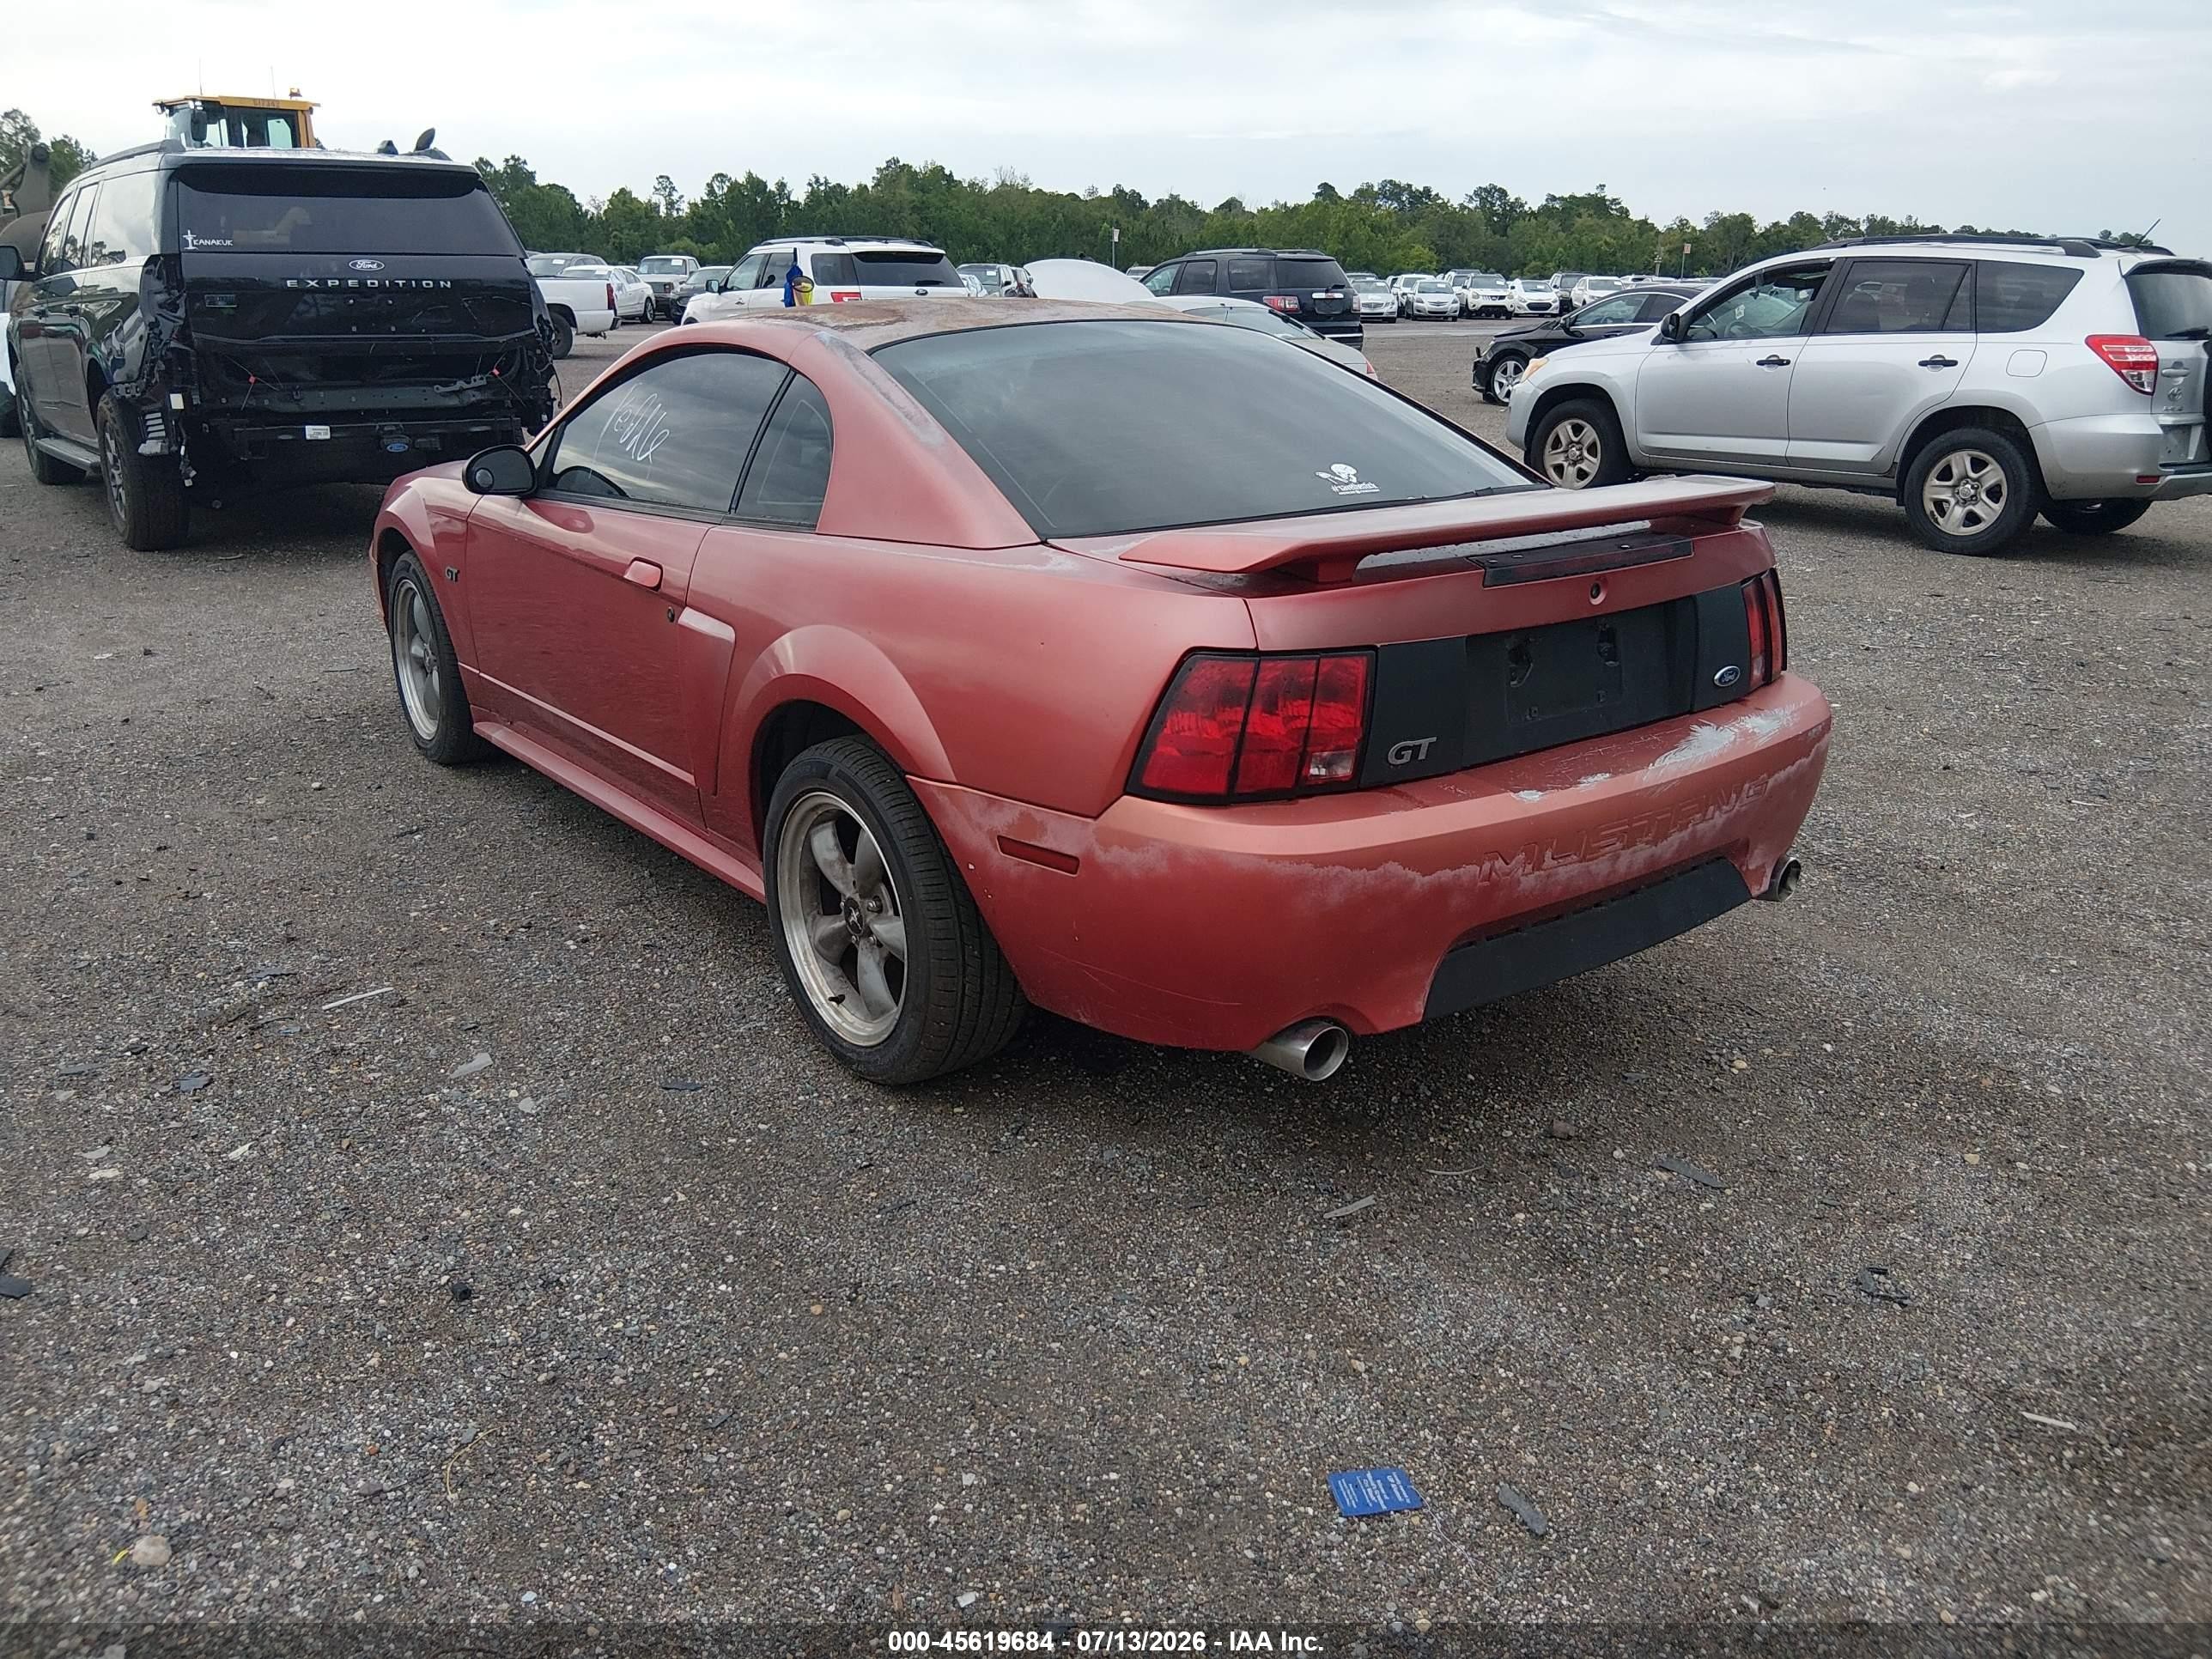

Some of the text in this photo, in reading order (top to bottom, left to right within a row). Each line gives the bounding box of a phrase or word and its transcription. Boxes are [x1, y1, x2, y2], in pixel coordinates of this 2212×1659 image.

[354, 259, 380, 270] Ford
[286, 279, 452, 289] EXPEDITION
[1388, 737, 1437, 765] GT
[1477, 775, 1771, 887] MUSTANG
